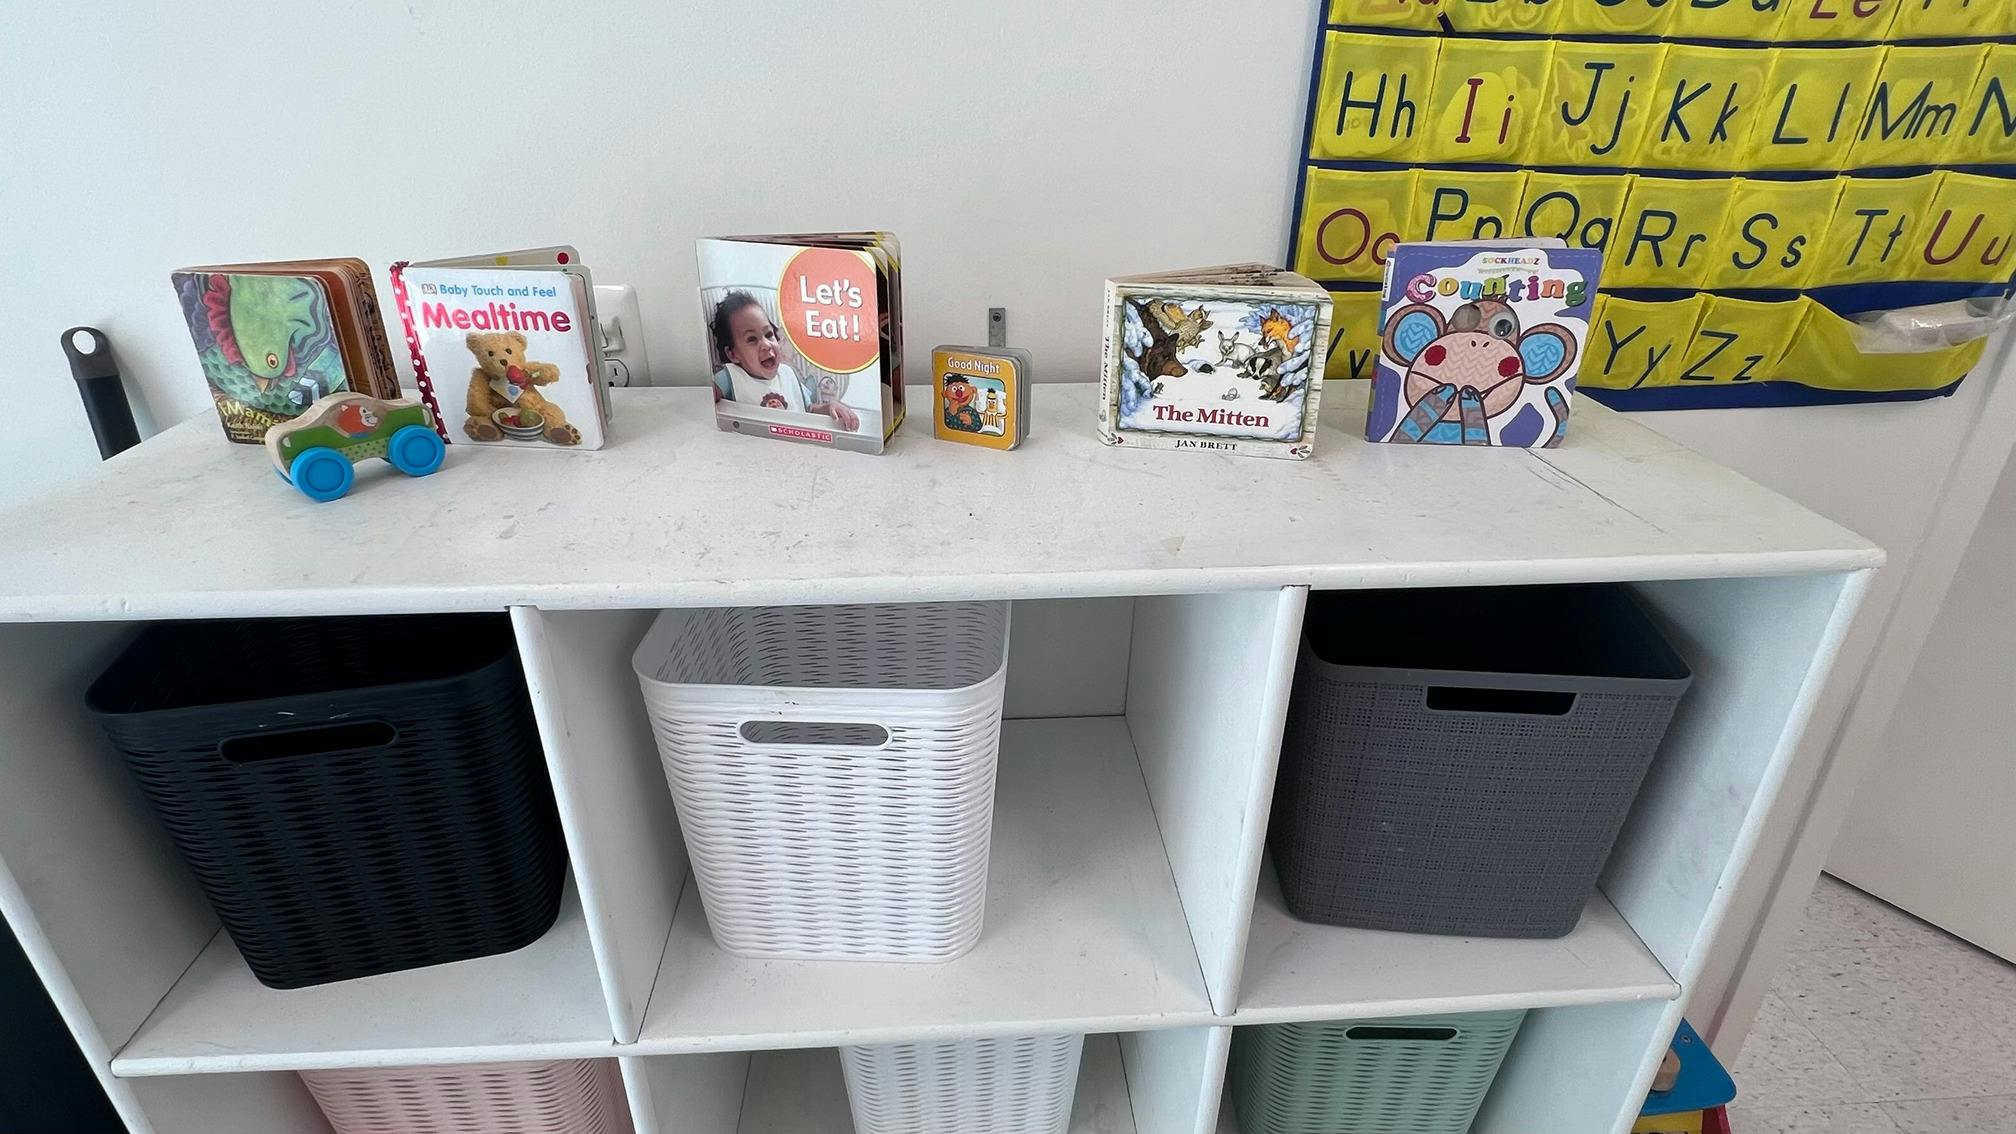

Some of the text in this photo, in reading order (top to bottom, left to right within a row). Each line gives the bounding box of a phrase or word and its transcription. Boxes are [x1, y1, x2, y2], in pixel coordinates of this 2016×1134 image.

[1336, 71, 1416, 138] Hh
[1455, 78, 1515, 144] Ii
[1561, 62, 1635, 155] Jj
[1661, 78, 1739, 144] Kk
[1860, 80, 1957, 141] Mm
[1316, 208, 1400, 265] Oo
[1624, 209, 1707, 268] Rr
[1732, 213, 1807, 270] Ss
[1847, 209, 1906, 266] Tt
[1923, 209, 2015, 265] Uu
[1482, 257, 1540, 265] SOCKHEADZ
[439, 284, 468, 297] Baby
[472, 285, 504, 296] Touch
[507, 285, 529, 297] and
[532, 286, 557, 297] Feel
[800, 275, 863, 308] Let's
[1405, 272, 1589, 307] Counting
[422, 302, 572, 332] Mealtime
[947, 356, 1000, 375] Good Night
[1602, 319, 1672, 389] Yy
[1680, 330, 1764, 381] Zz
[1153, 404, 1270, 428] The Mitten
[777, 427, 831, 441] SCHOLASTIC
[1175, 439, 1238, 451] JAN BRETT
